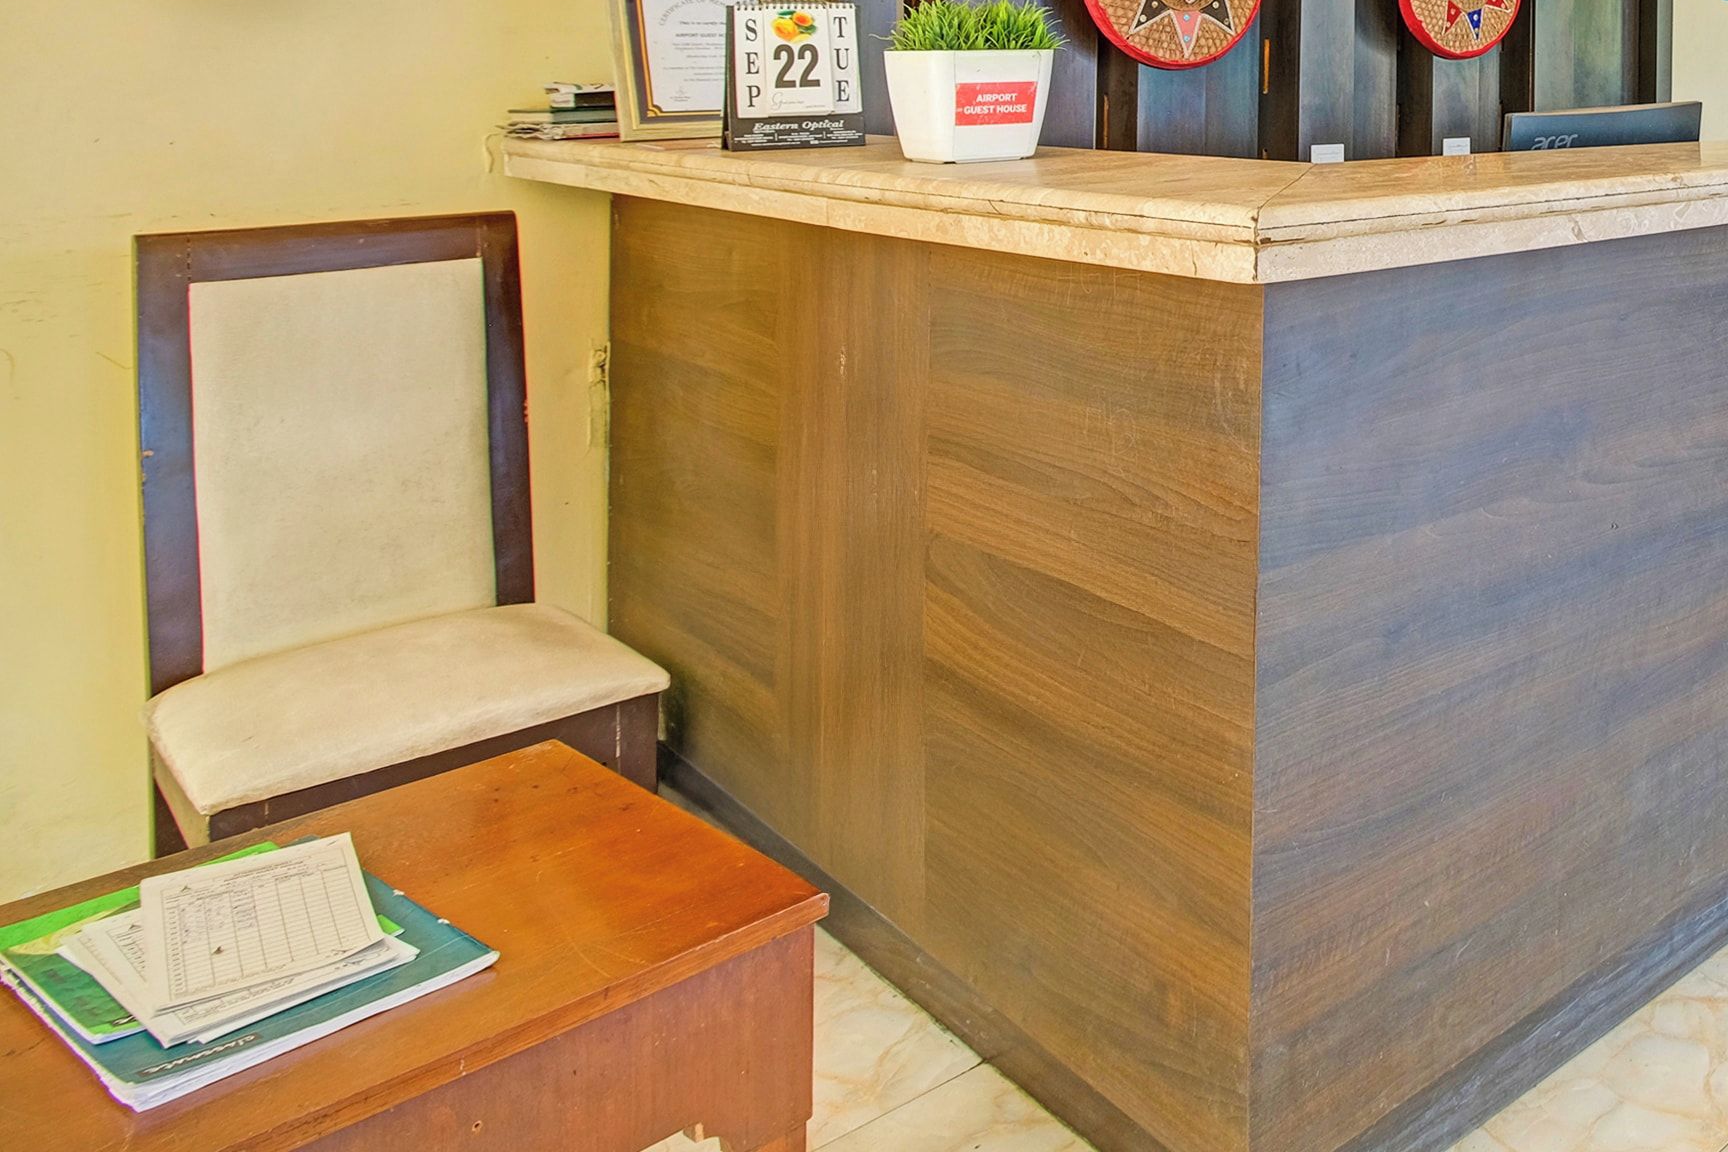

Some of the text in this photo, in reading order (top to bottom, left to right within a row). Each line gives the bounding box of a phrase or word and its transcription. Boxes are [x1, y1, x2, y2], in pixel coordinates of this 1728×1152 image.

[659, 0, 694, 26] CERTIFICATE
[745, 19, 761, 108] SEP
[773, 44, 821, 89] 22
[833, 16, 850, 102] TUE
[976, 93, 1018, 102] AIRPORT
[963, 104, 1027, 115] GUEST HOUSE
[753, 119, 844, 131] Eastern Optical
[1530, 133, 1579, 149] acer
